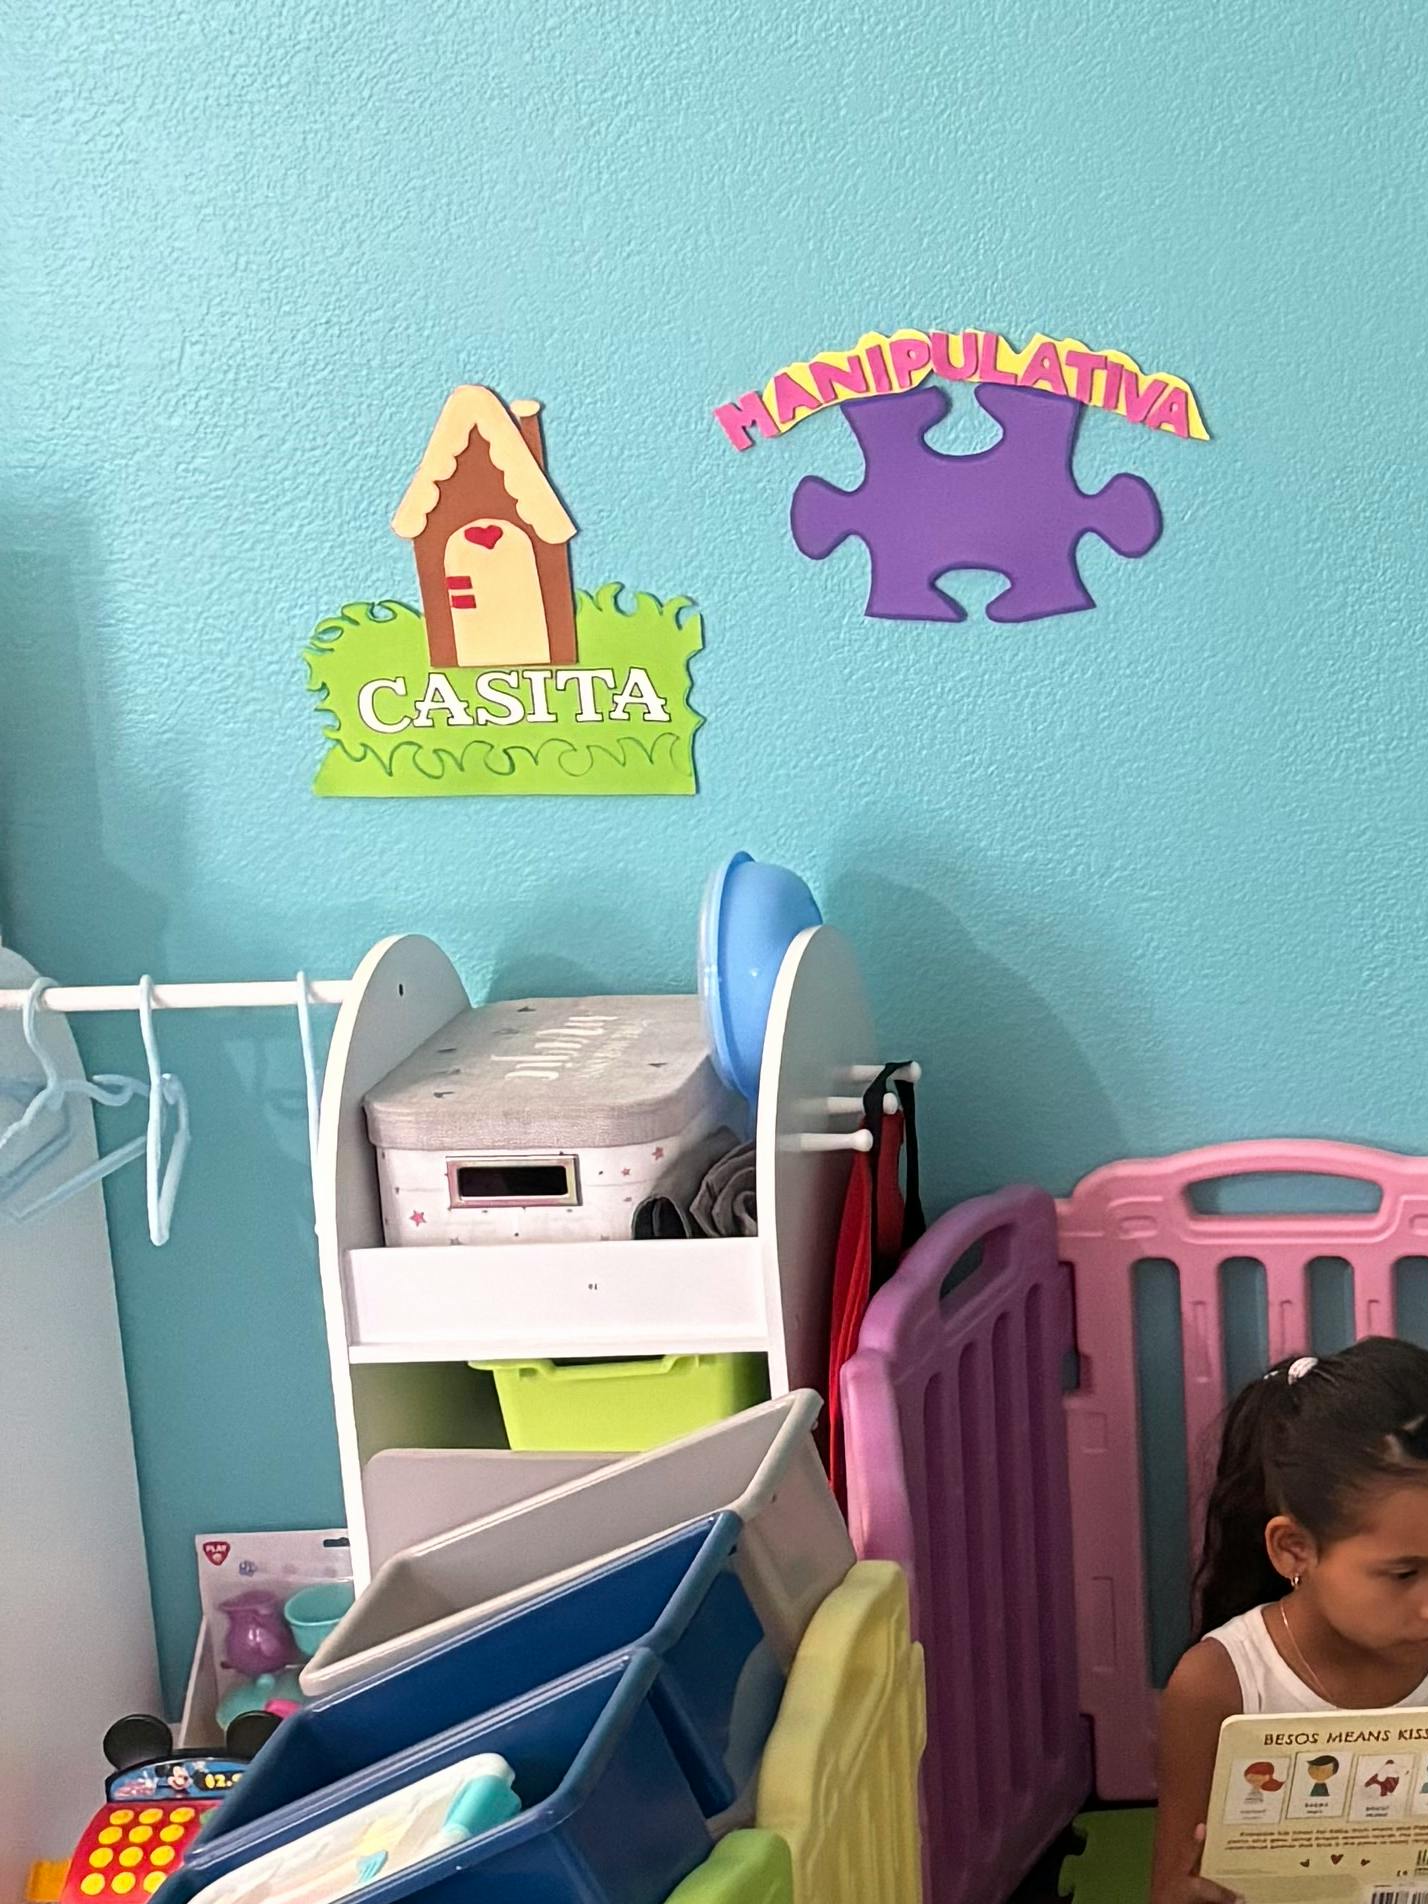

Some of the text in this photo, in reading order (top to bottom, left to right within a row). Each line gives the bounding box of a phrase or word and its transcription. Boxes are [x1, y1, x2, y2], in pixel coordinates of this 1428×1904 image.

[713, 328, 1192, 452] MANIPULATIVA
[357, 667, 672, 734] CASITA
[1263, 1733, 1319, 1745] BESOS
[1326, 1730, 1390, 1744] MEANS
